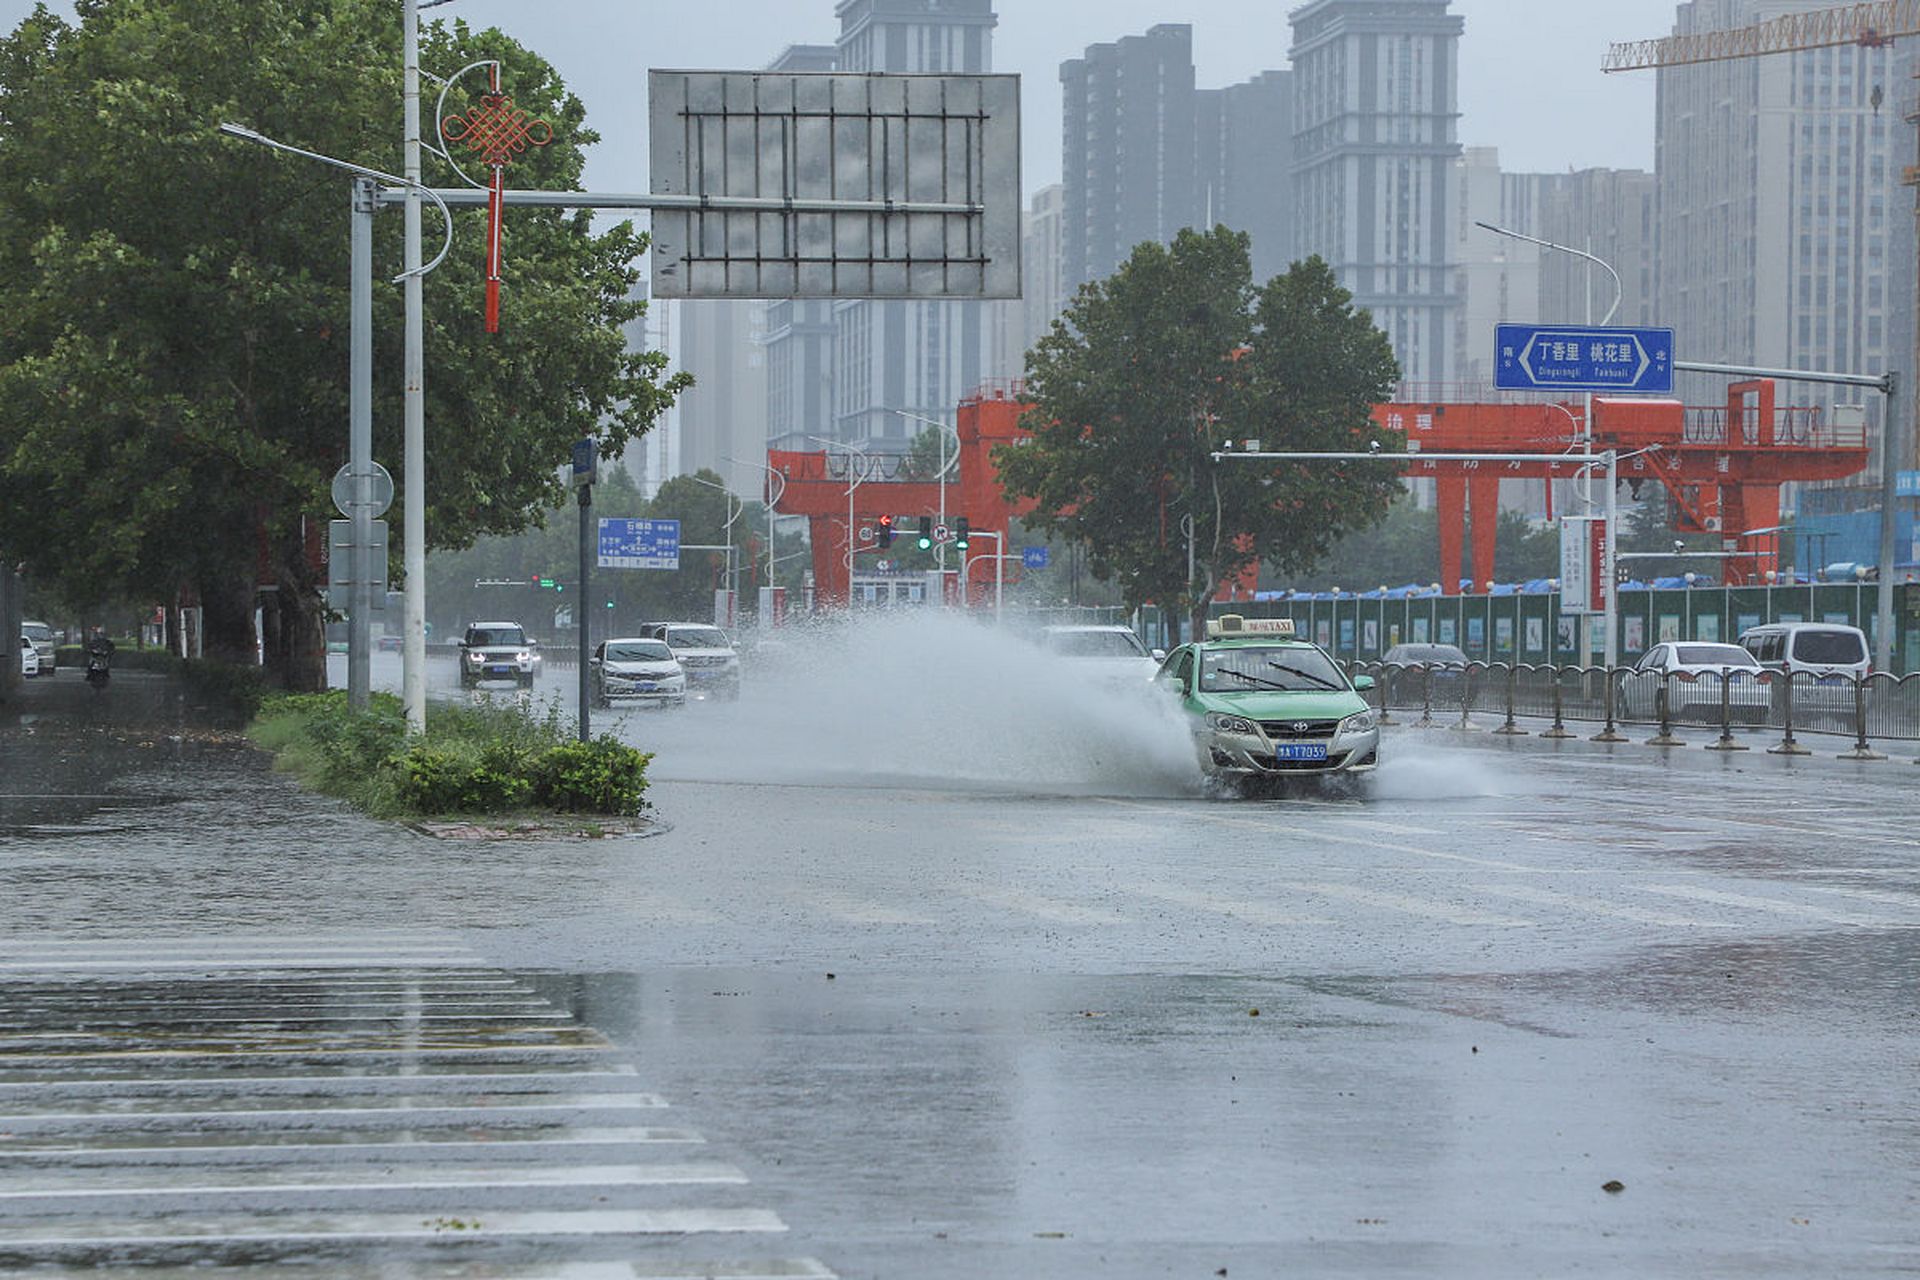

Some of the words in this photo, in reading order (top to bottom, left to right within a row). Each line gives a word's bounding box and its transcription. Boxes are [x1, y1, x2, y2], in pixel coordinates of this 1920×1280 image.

[1503, 346, 1514, 358] 南
[1538, 342, 1580, 361] 丁香里
[1590, 343, 1632, 363] 桃花里
[1656, 351, 1667, 361] 北
[1269, 621, 1291, 631] TAXI
